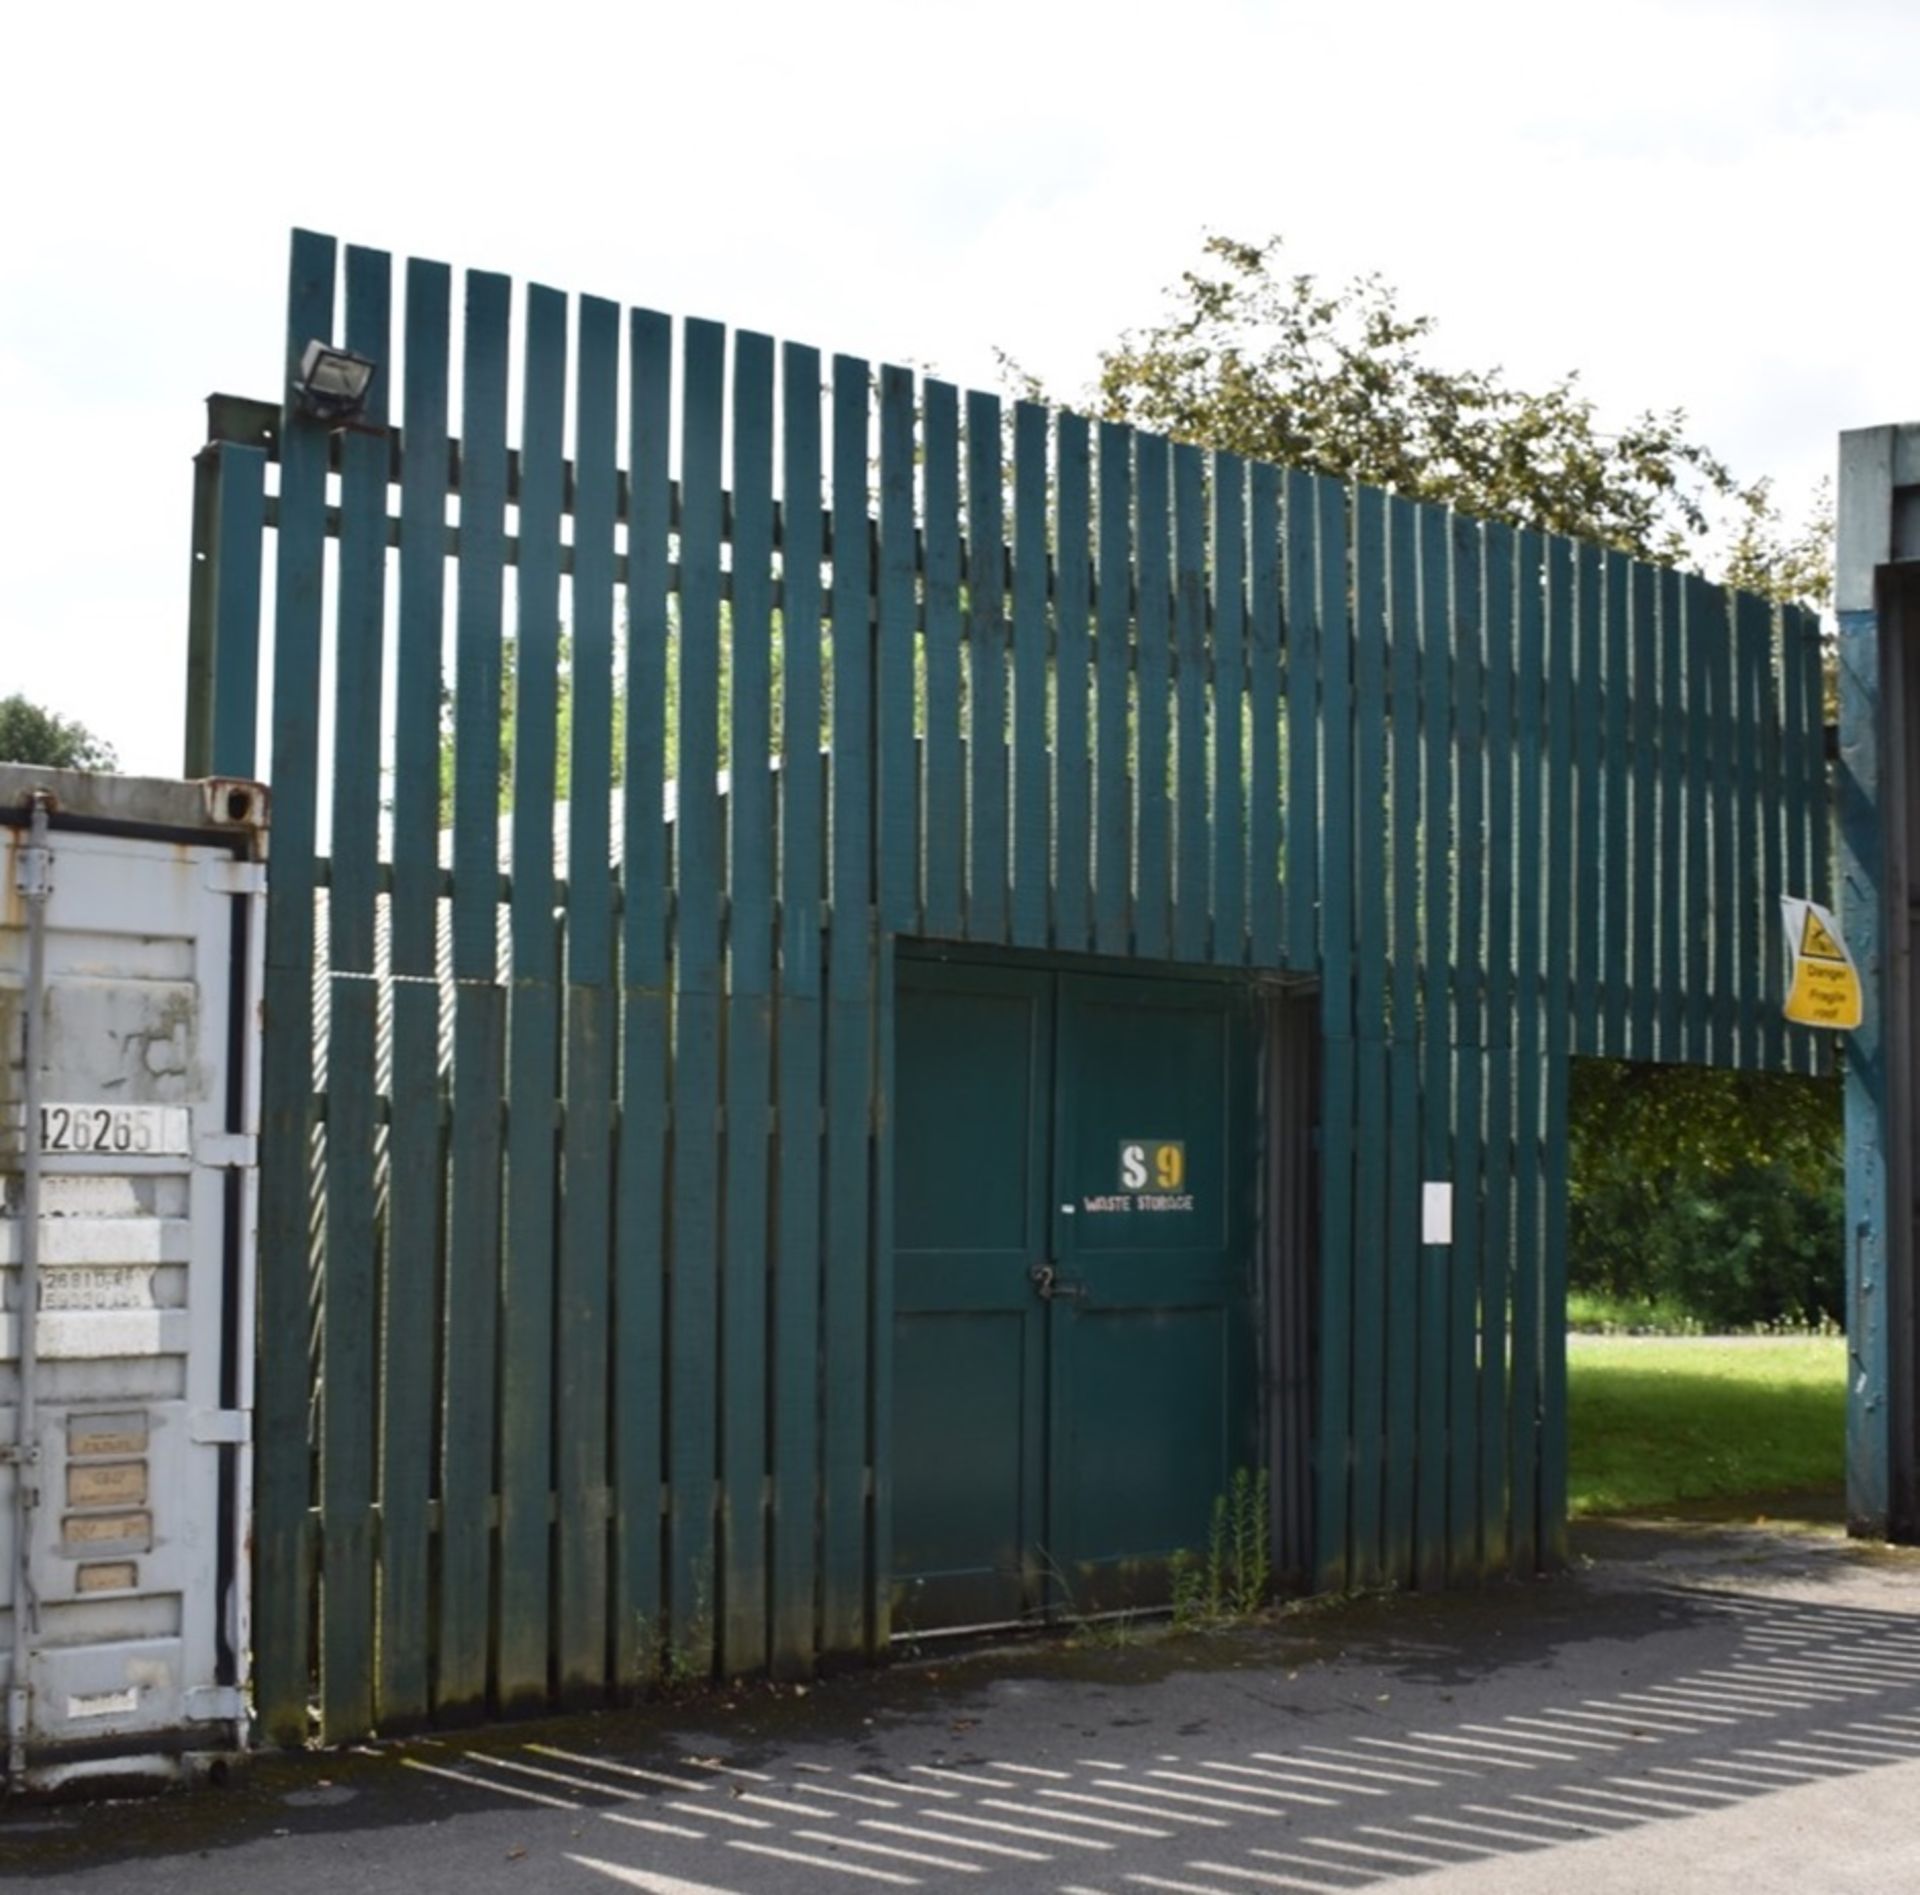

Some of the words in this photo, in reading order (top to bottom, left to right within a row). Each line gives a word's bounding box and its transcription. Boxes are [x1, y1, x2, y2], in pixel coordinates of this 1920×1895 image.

[1808, 964, 1847, 982] Danger
[1122, 1145, 1147, 1189] S
[1156, 1145, 1182, 1189] 9
[1084, 1195, 1130, 1212] WASTE
[1137, 1195, 1193, 1211] STORAGE
